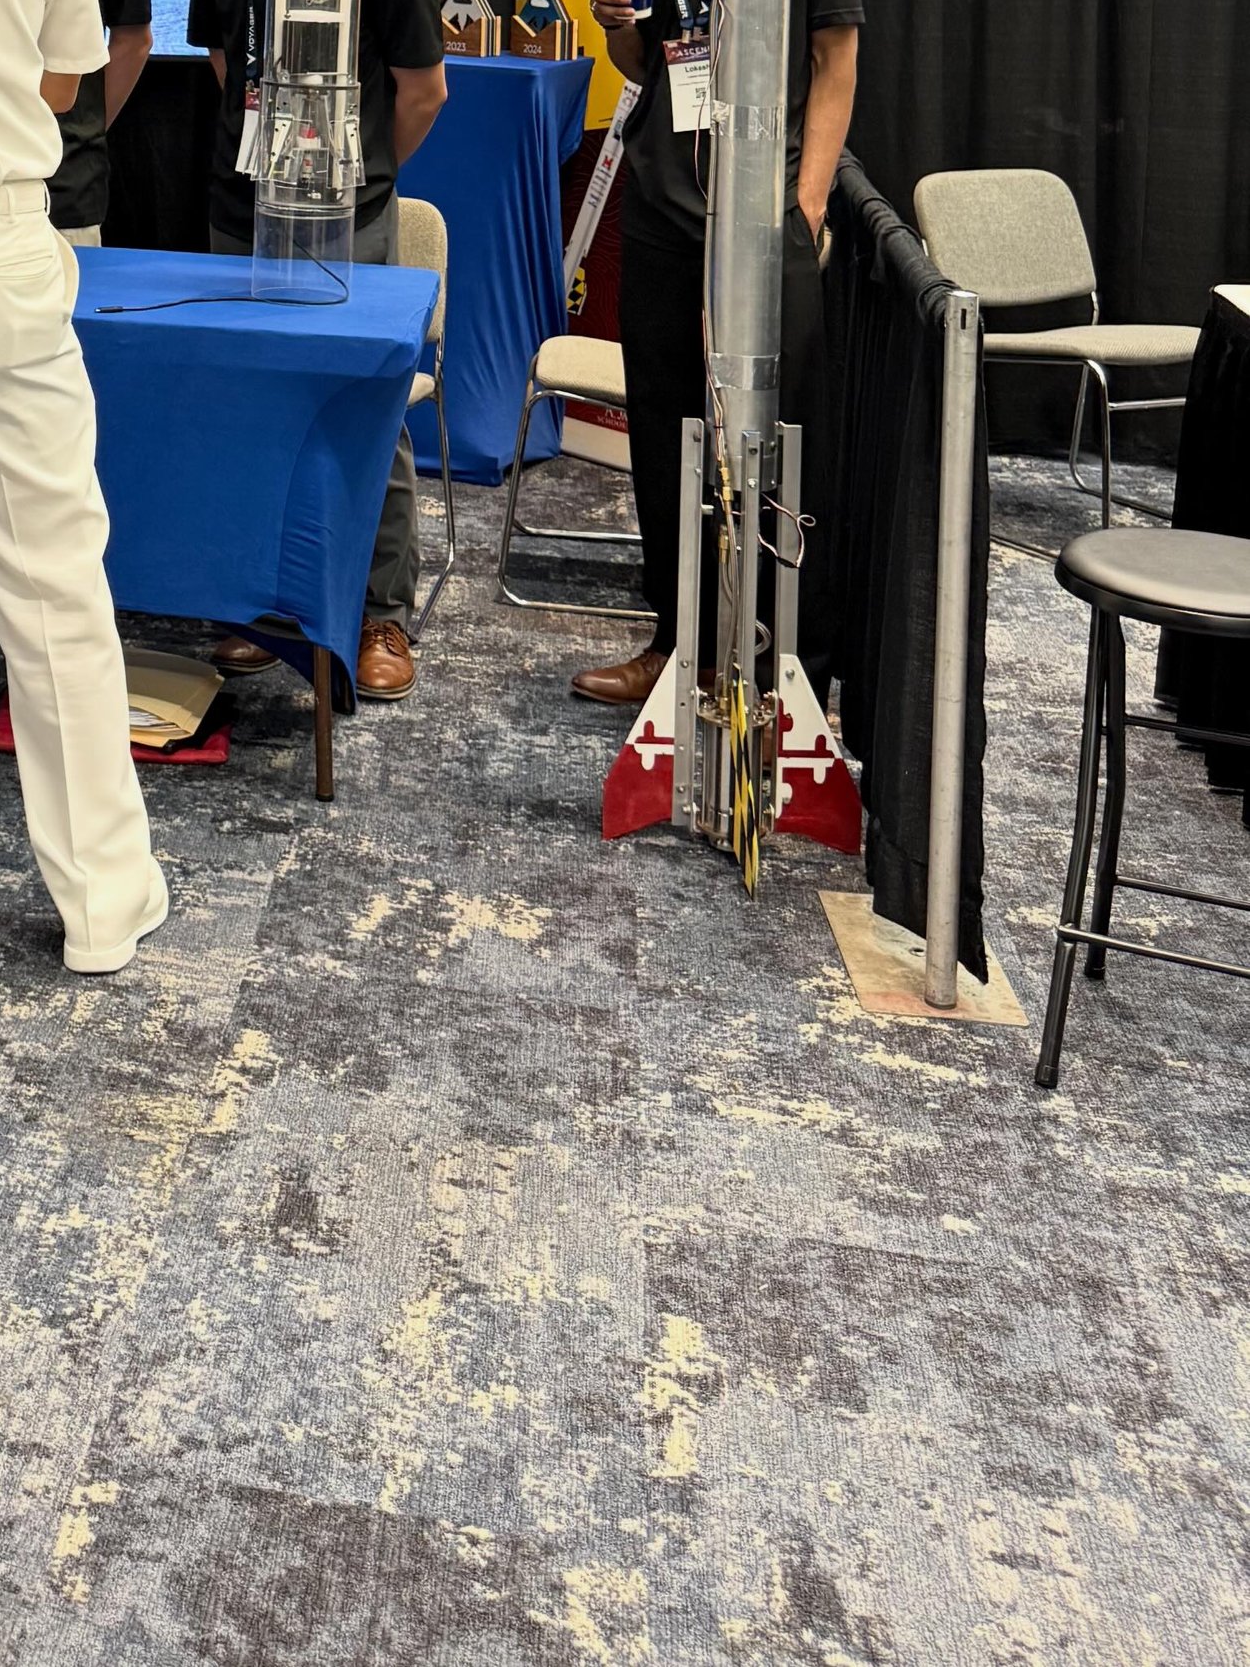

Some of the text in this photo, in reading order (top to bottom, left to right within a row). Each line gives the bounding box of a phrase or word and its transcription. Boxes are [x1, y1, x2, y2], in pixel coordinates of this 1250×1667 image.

[445, 41, 467, 52] 2023
[523, 43, 542, 54] 2024
[675, 45, 710, 58] ASCEN
